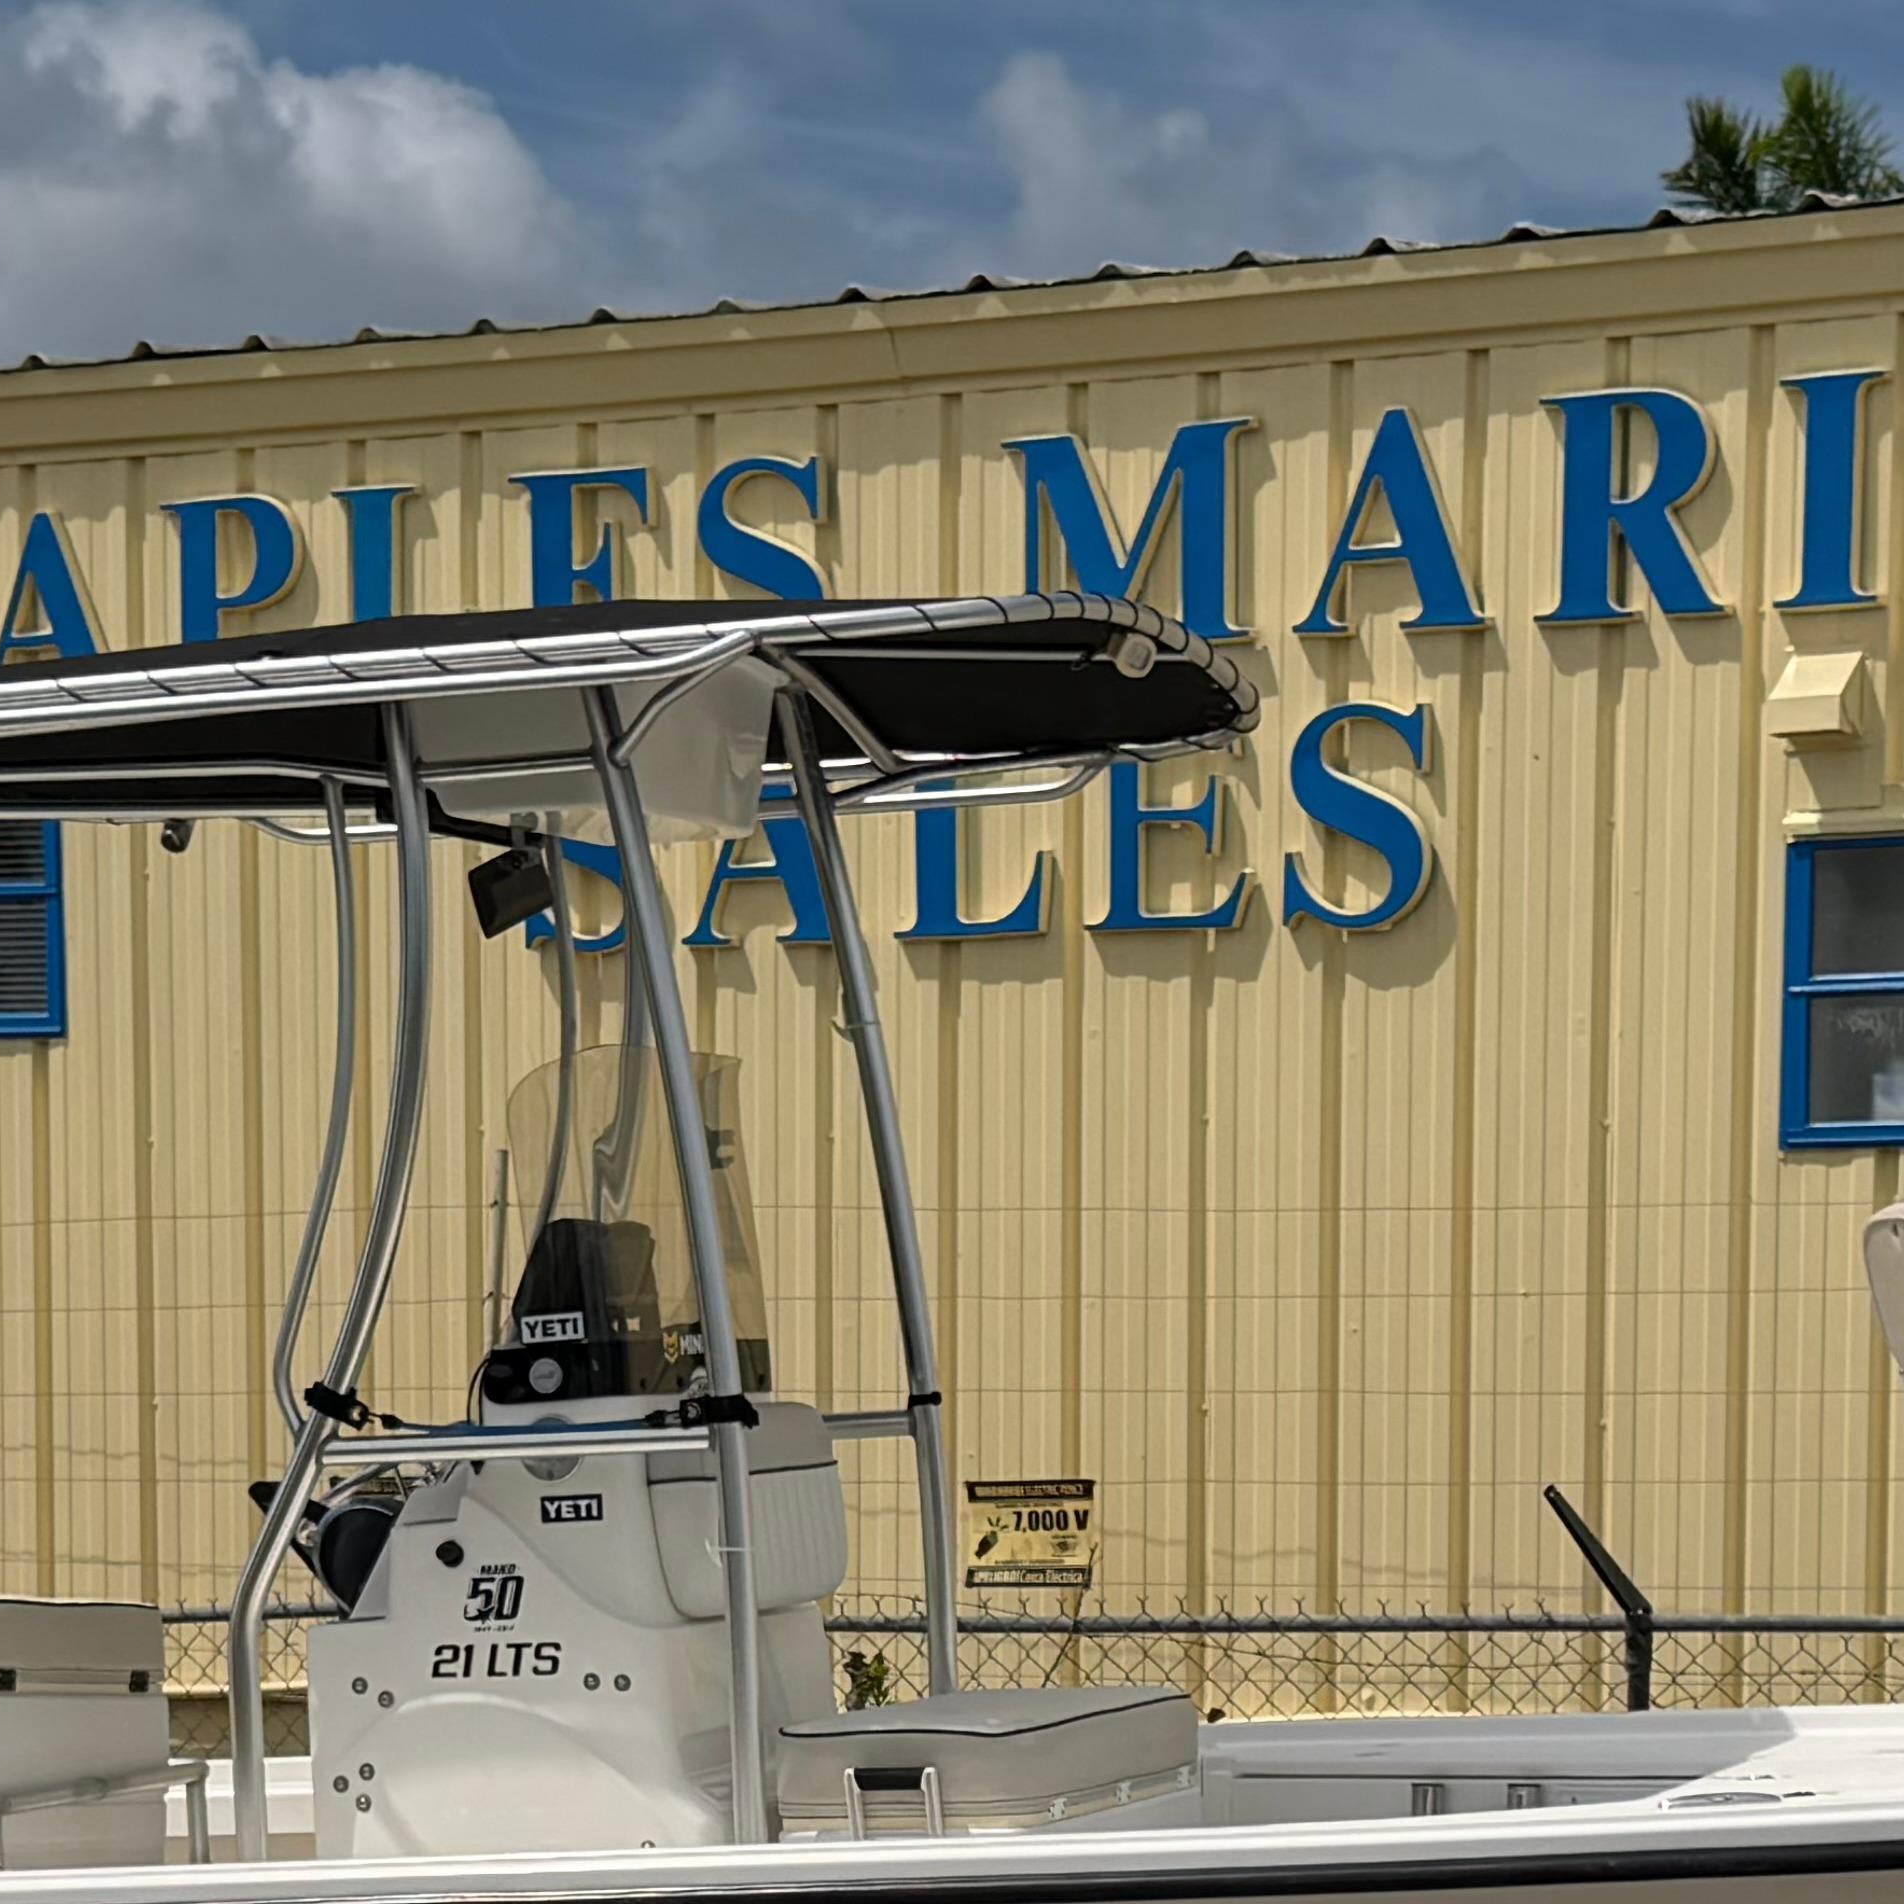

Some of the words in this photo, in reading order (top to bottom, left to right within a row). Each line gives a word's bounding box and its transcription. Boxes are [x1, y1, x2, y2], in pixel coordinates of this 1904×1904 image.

[524, 1317, 579, 1339] YETI
[544, 1498, 598, 1519] YETI
[1073, 1508, 1089, 1531] V
[464, 1575, 524, 1622] 50
[432, 1643, 474, 1678] 21
[487, 1641, 562, 1677] LTS
